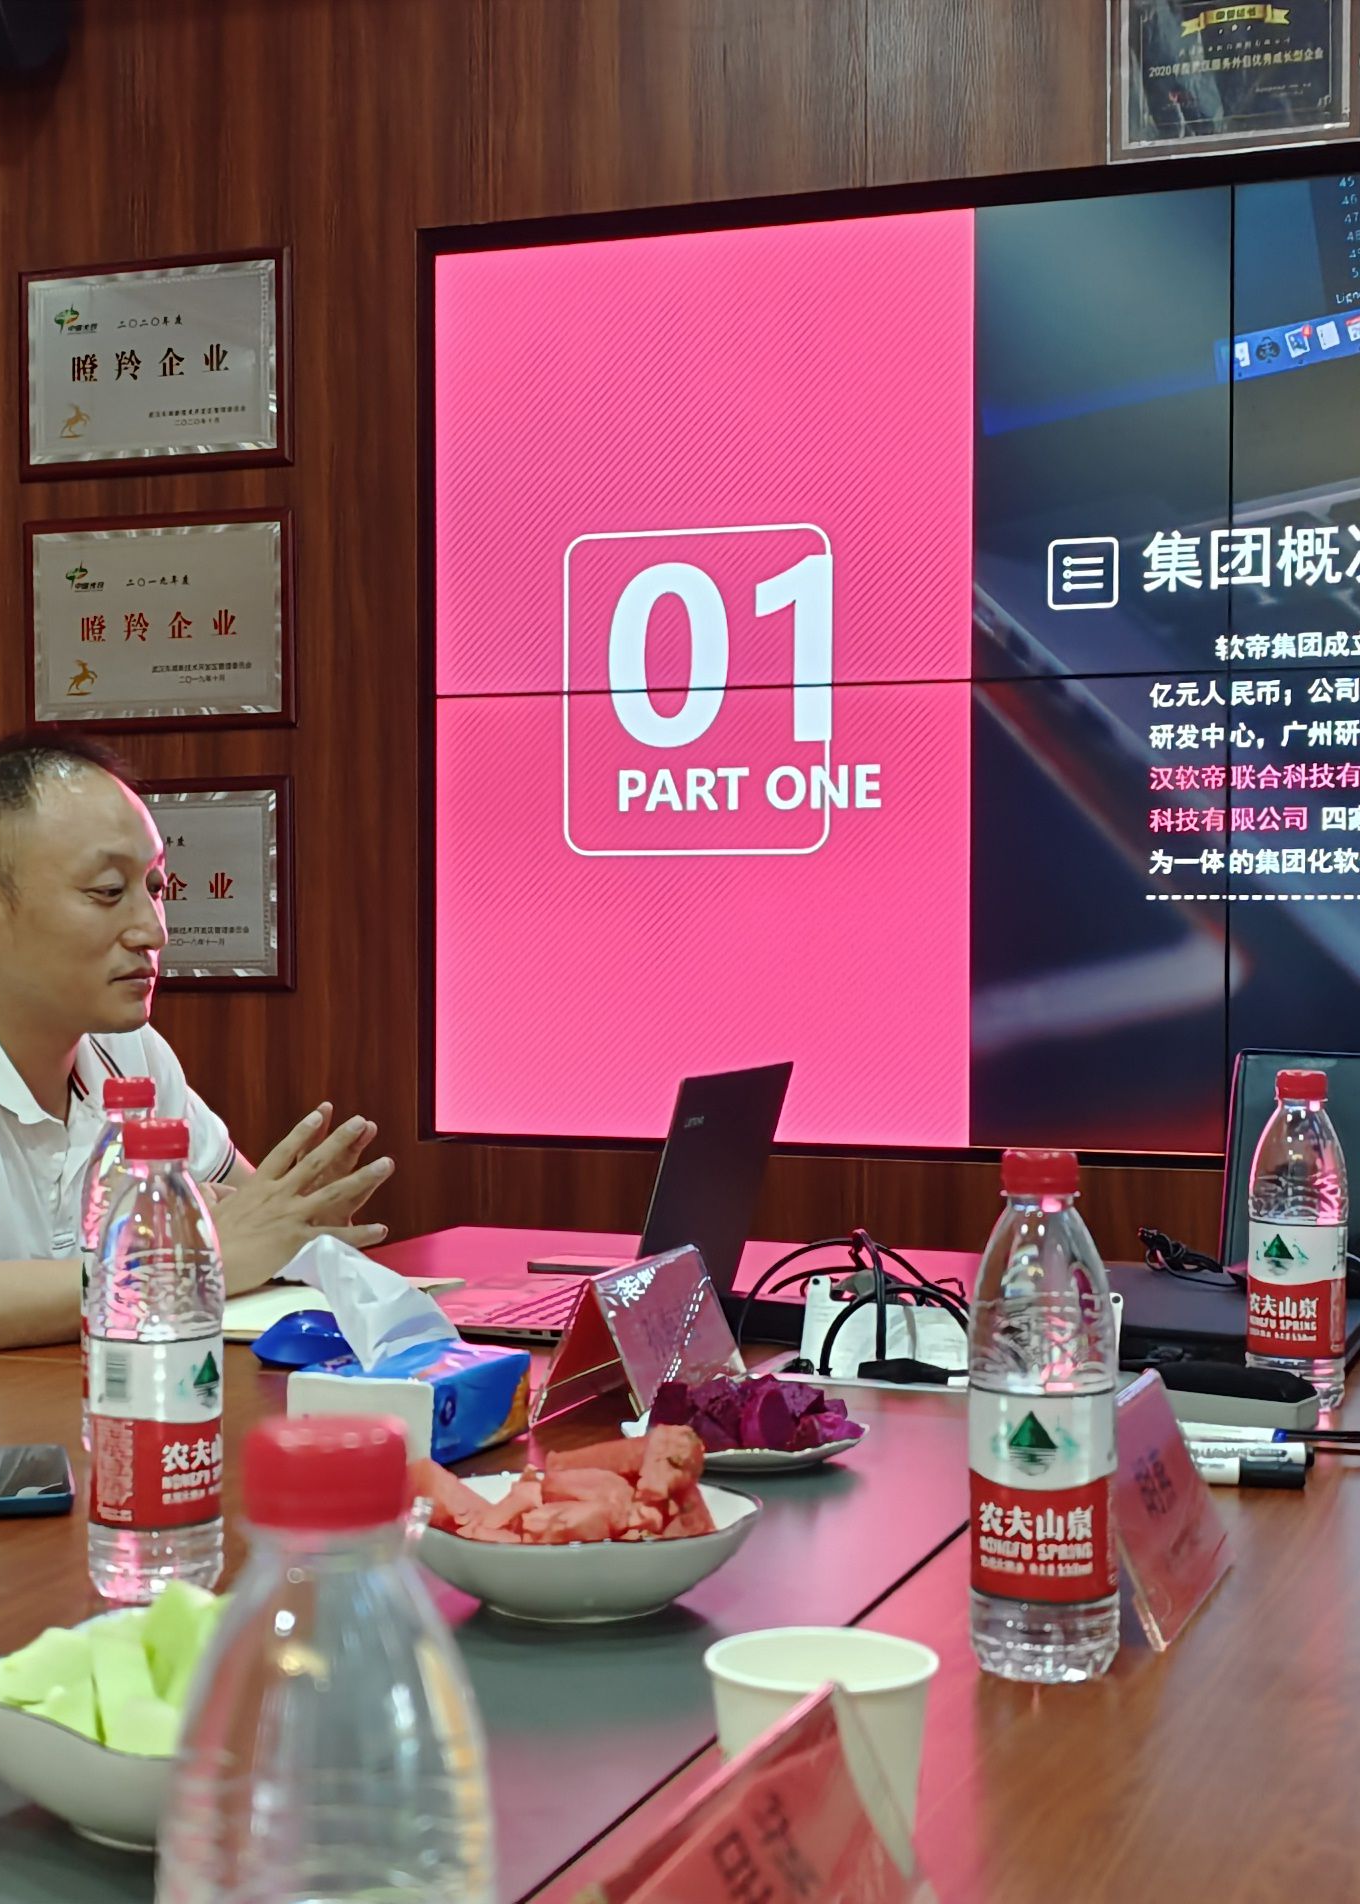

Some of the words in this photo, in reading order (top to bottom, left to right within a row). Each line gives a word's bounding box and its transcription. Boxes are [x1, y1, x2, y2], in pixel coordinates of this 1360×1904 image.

[71, 343, 230, 383] 瞪羚企业
[80, 608, 238, 643] 瞪羚企业
[608, 554, 833, 748] 01
[618, 766, 750, 812] PART
[765, 764, 882, 810] ONE
[1148, 806, 1309, 834] 科技有限公司
[161, 872, 234, 901] 企业
[1249, 1292, 1319, 1319] 农夫山泉
[979, 1501, 1093, 1541] 农夫山泉
